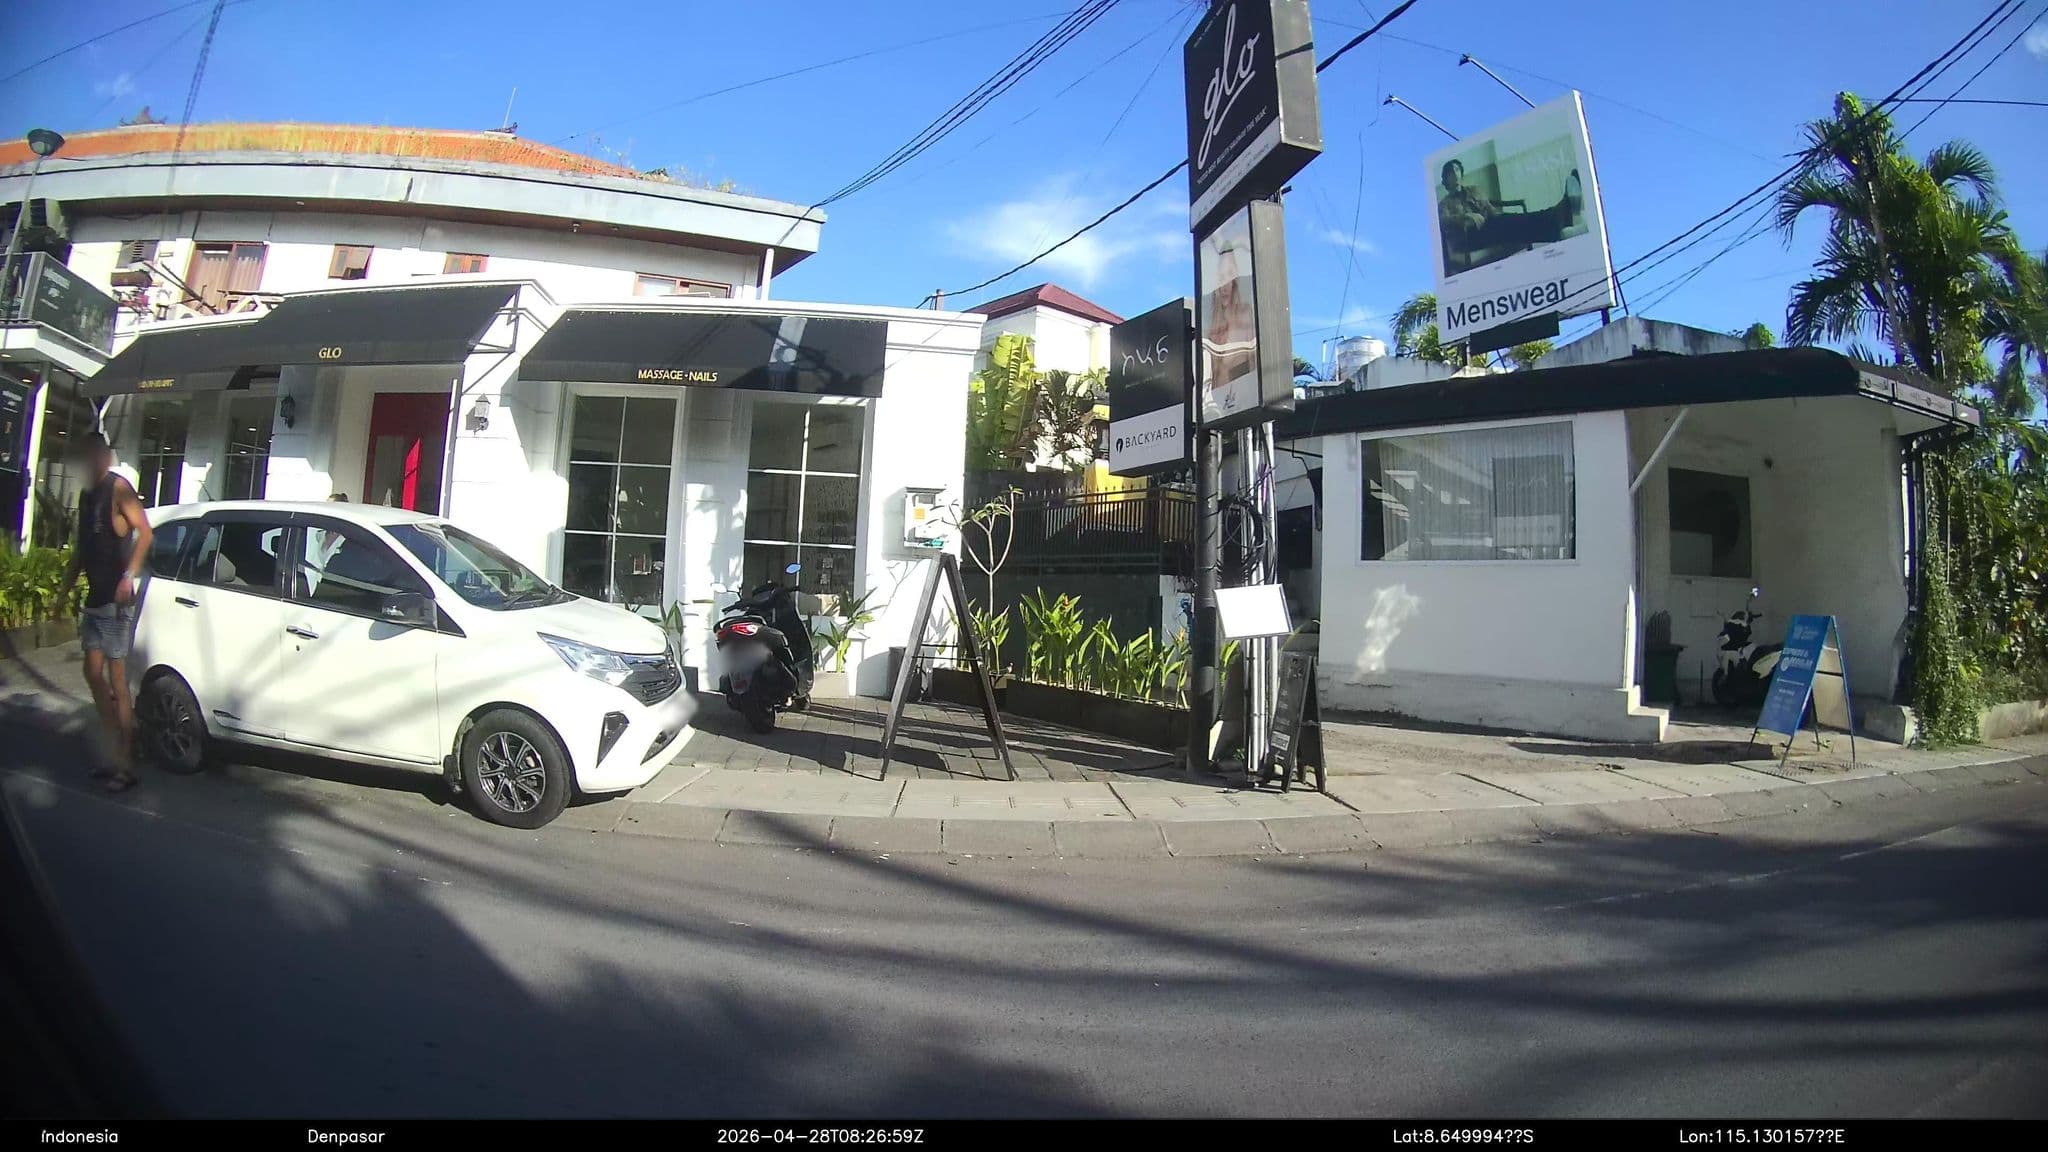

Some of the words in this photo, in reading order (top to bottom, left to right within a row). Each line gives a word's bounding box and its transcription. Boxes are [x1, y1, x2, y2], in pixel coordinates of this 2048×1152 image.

[1197, 3, 1261, 170] glo
[1445, 277, 1570, 331] Menswear
[318, 346, 342, 360] GLO
[637, 368, 684, 381] MASSAGE
[688, 370, 718, 383] NAILS
[1125, 424, 1178, 449] BACKYARD
